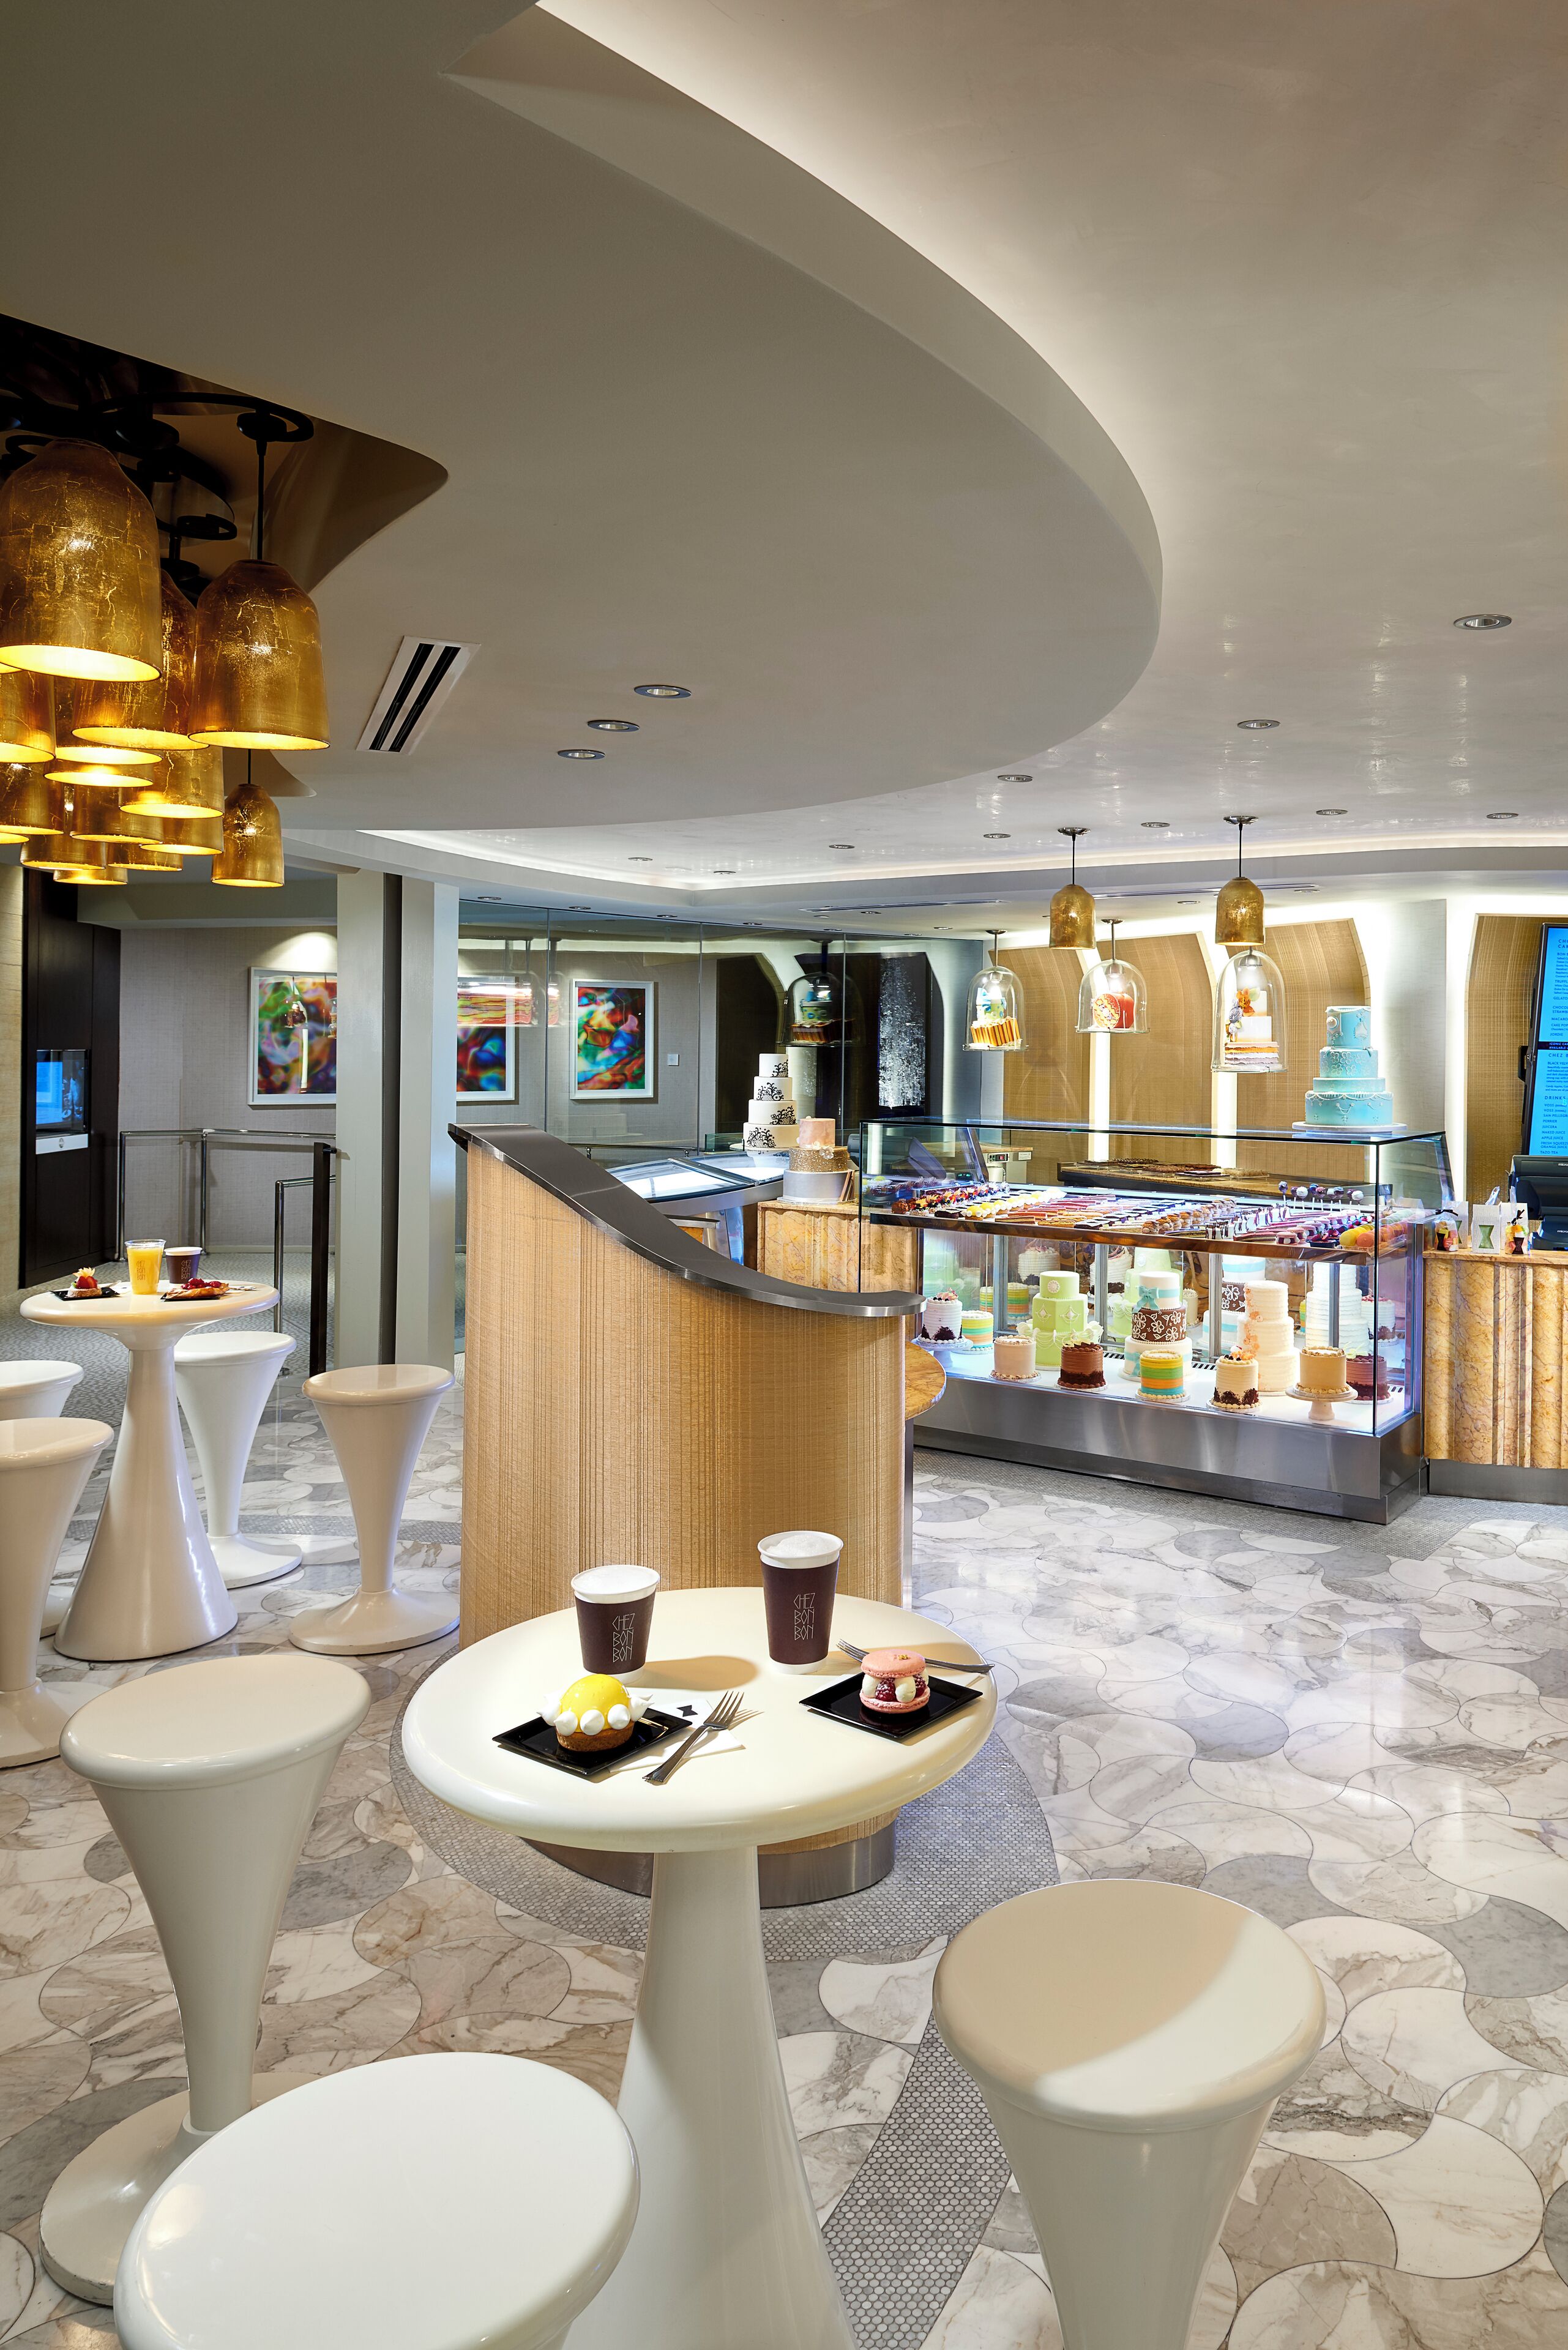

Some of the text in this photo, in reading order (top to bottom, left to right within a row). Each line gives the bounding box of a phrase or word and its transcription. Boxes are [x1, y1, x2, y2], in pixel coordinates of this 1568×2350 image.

[793, 1592, 816, 1610] CHEZ
[612, 1613, 635, 1631] CHEZ
[794, 1608, 815, 1625] BON
[613, 1629, 634, 1647] BON
[794, 1624, 814, 1641] BON
[613, 1645, 633, 1663] BON
